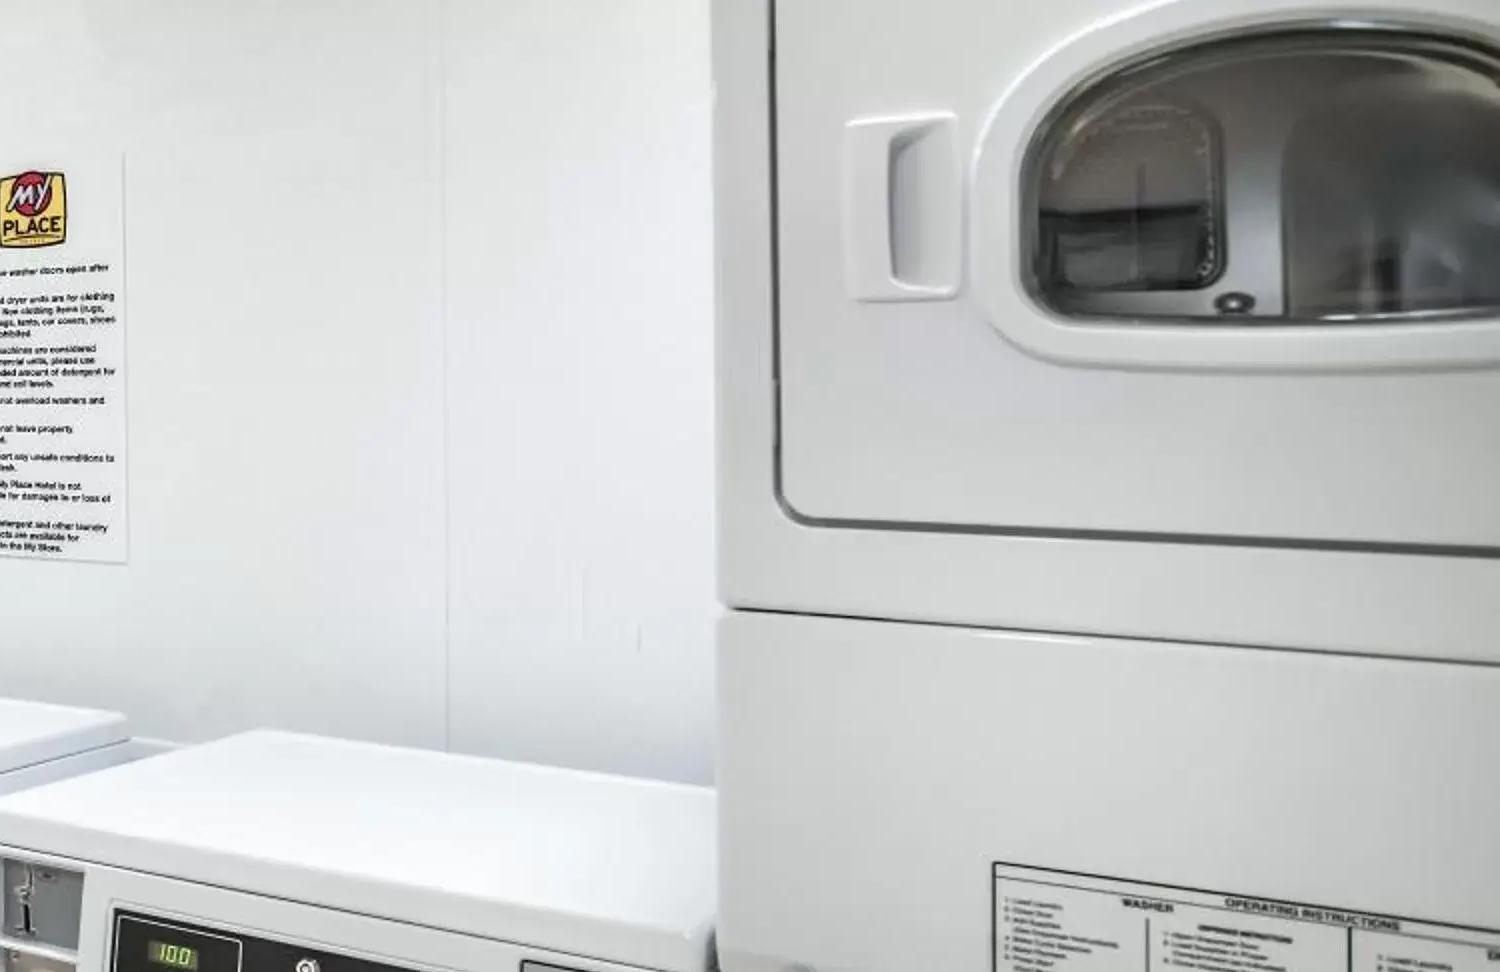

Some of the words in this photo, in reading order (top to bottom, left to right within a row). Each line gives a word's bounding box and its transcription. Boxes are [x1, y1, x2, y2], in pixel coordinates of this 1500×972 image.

[3, 216, 61, 236] PLACE
[40, 267, 64, 275] doors
[89, 264, 108, 272] after
[7, 297, 27, 305] dryer
[66, 294, 78, 302] for
[81, 292, 114, 301] clothing
[51, 368, 59, 376] of
[102, 494, 111, 502] of
[1122, 898, 1174, 913] WASHER
[1224, 897, 1299, 916] OPERATING
[1302, 907, 1400, 931] INSTRUCTIONS
